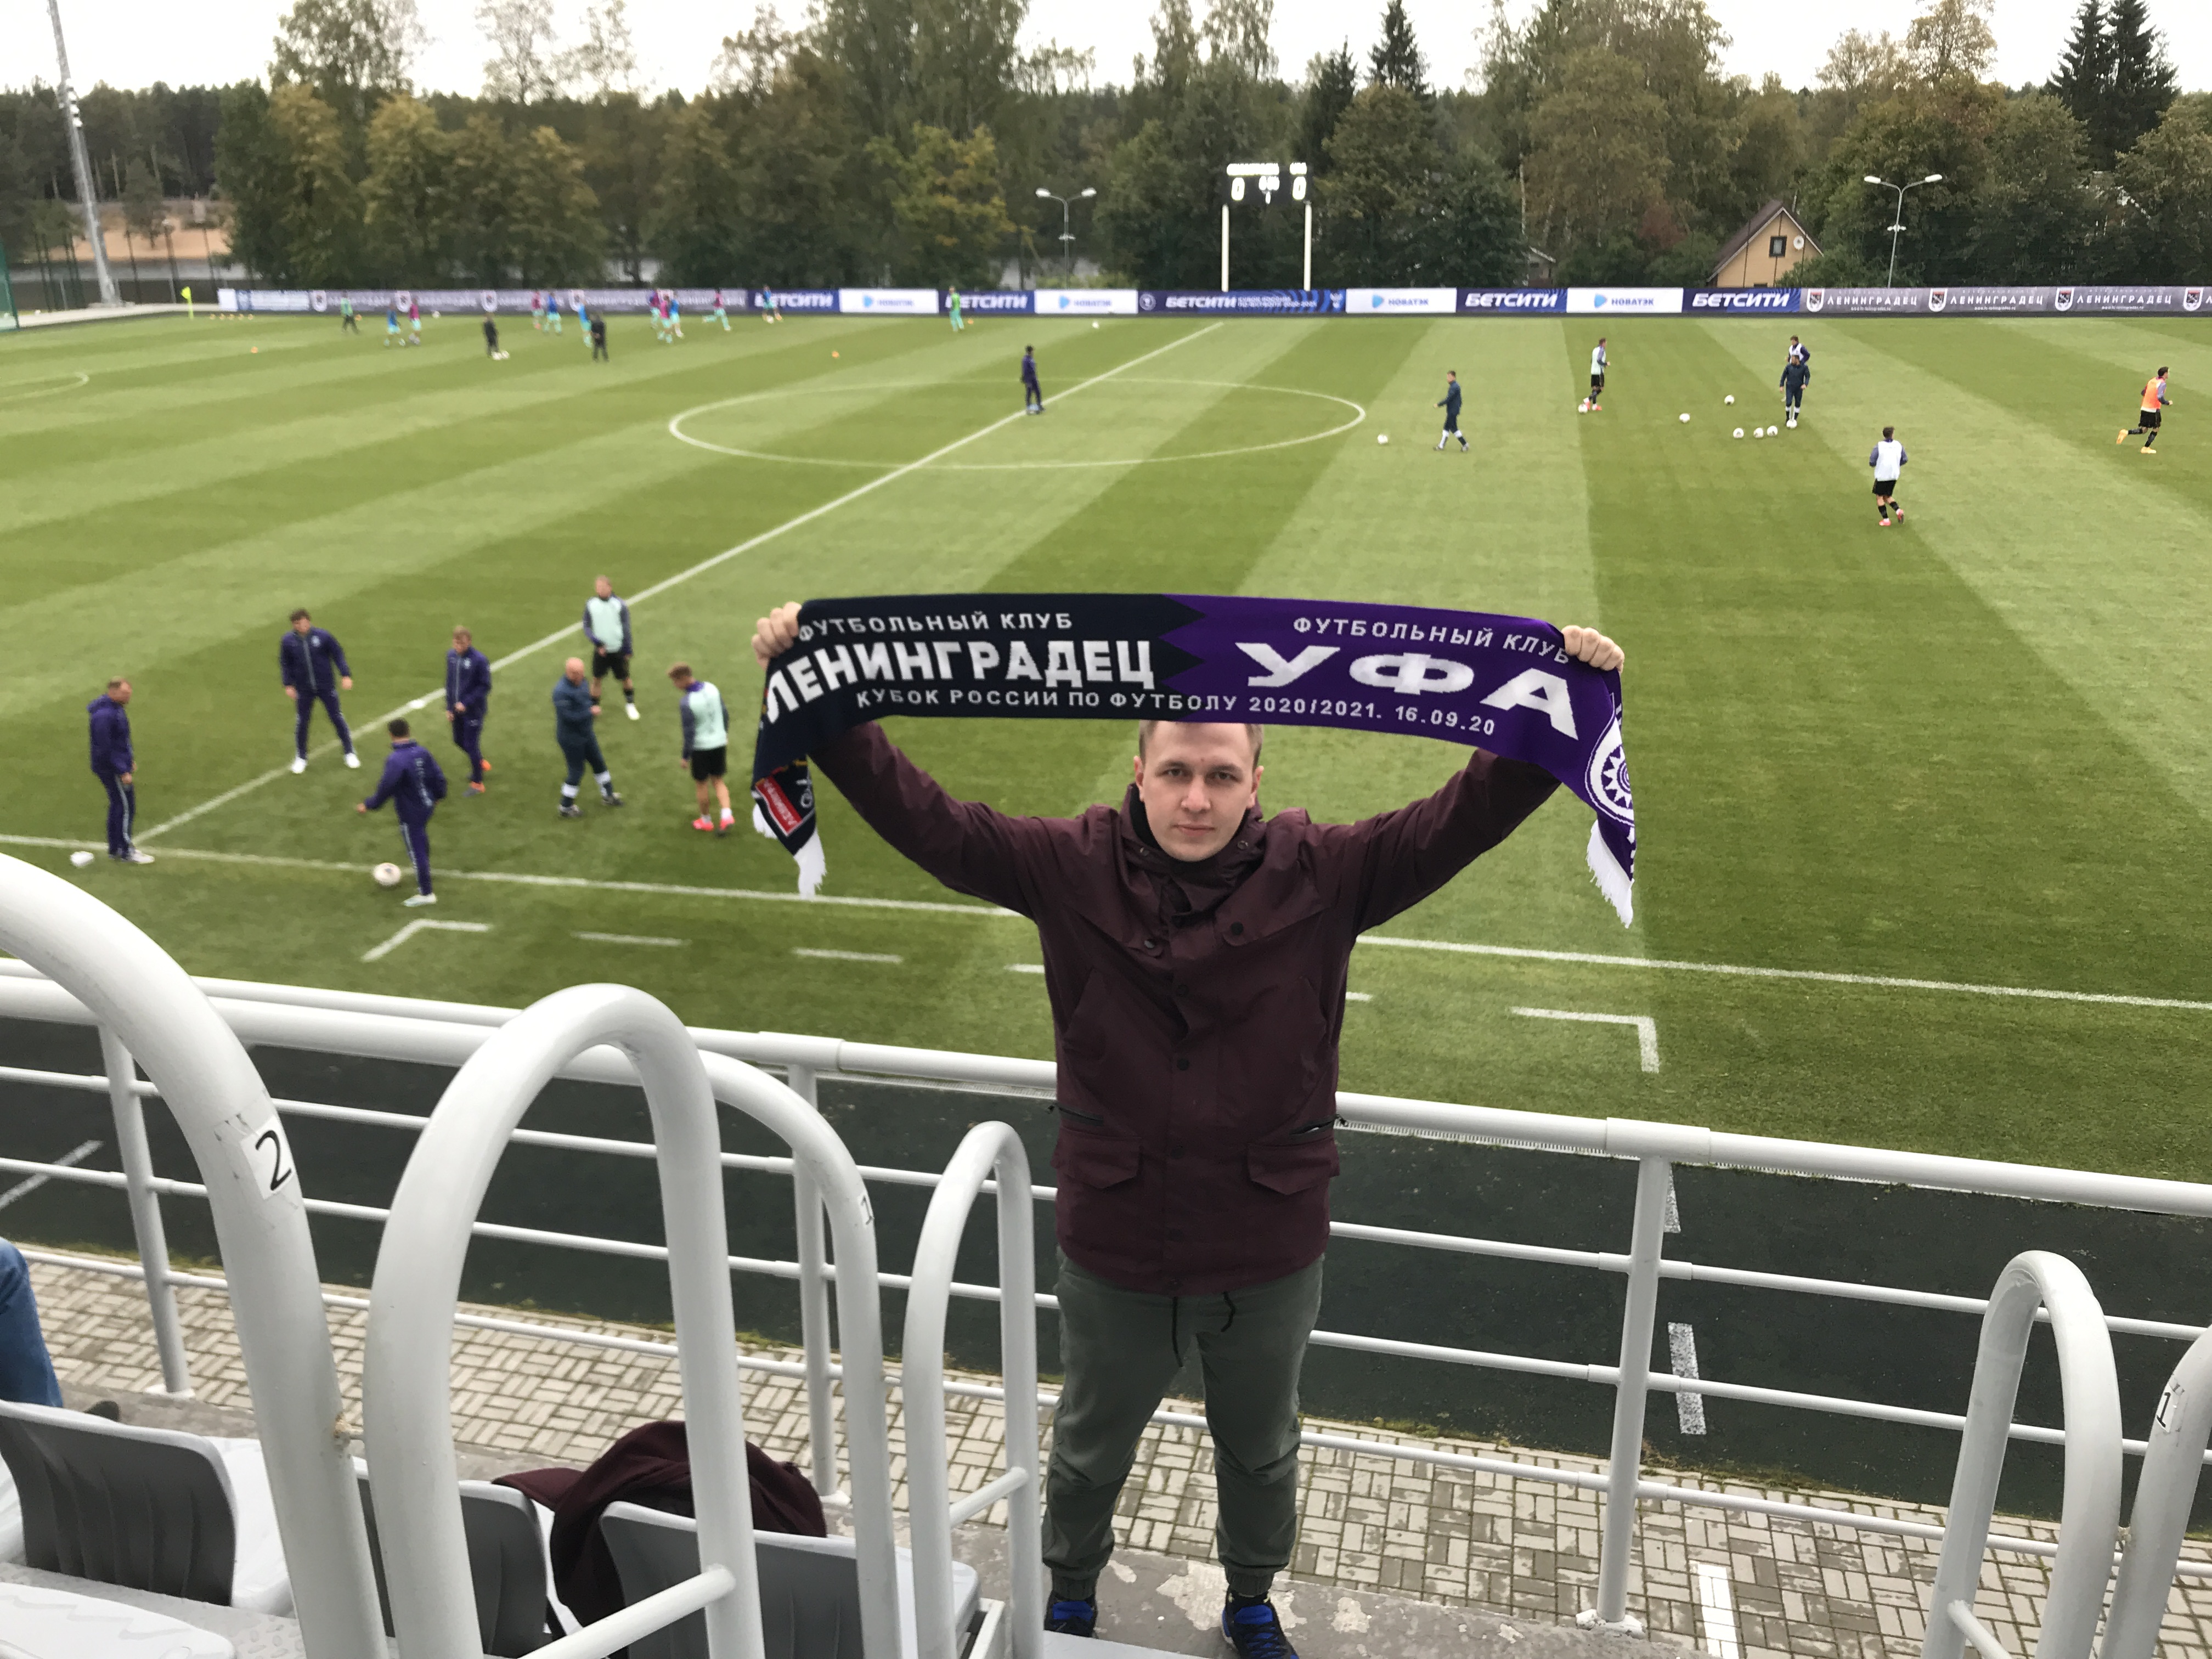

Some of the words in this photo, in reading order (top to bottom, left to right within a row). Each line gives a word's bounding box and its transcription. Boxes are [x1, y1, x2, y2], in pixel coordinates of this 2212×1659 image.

[1166, 296, 1237, 308] БЕТСИТИ
[1465, 293, 1558, 307] БЕТСИТИ
[1611, 297, 1654, 306] НОВАТЭК
[1692, 293, 1790, 307] БЕТСИТИ
[1827, 296, 1917, 306] ЛЕНИНГРАДЕЦ
[1950, 295, 2043, 305] ЛЕНИНГРАДЕЦ
[2076, 295, 2172, 304] ЛЕНИНГРАДЕЦ
[799, 611, 989, 642] ФУТБОЛЬНЫЙ
[1000, 613, 1072, 629] КЛУБ
[1293, 617, 1493, 647] ФУТБОЛЬНЫЙ
[1503, 634, 1569, 664] КЛУБ
[767, 640, 1155, 724] ЛЕНИНГРАДЕЦ
[1234, 642, 1579, 741] УФА
[856, 689, 939, 708] КУБОК
[950, 690, 1058, 706] РОССИИ
[1069, 692, 1099, 706] ПО
[1110, 693, 1237, 711] ФУТБОЛУ
[1249, 697, 1382, 719] 2020/2021.
[1395, 706, 1496, 736] 16.09.20
[255, 1130, 292, 1191] 2
[2157, 1392, 2171, 1427] 1
